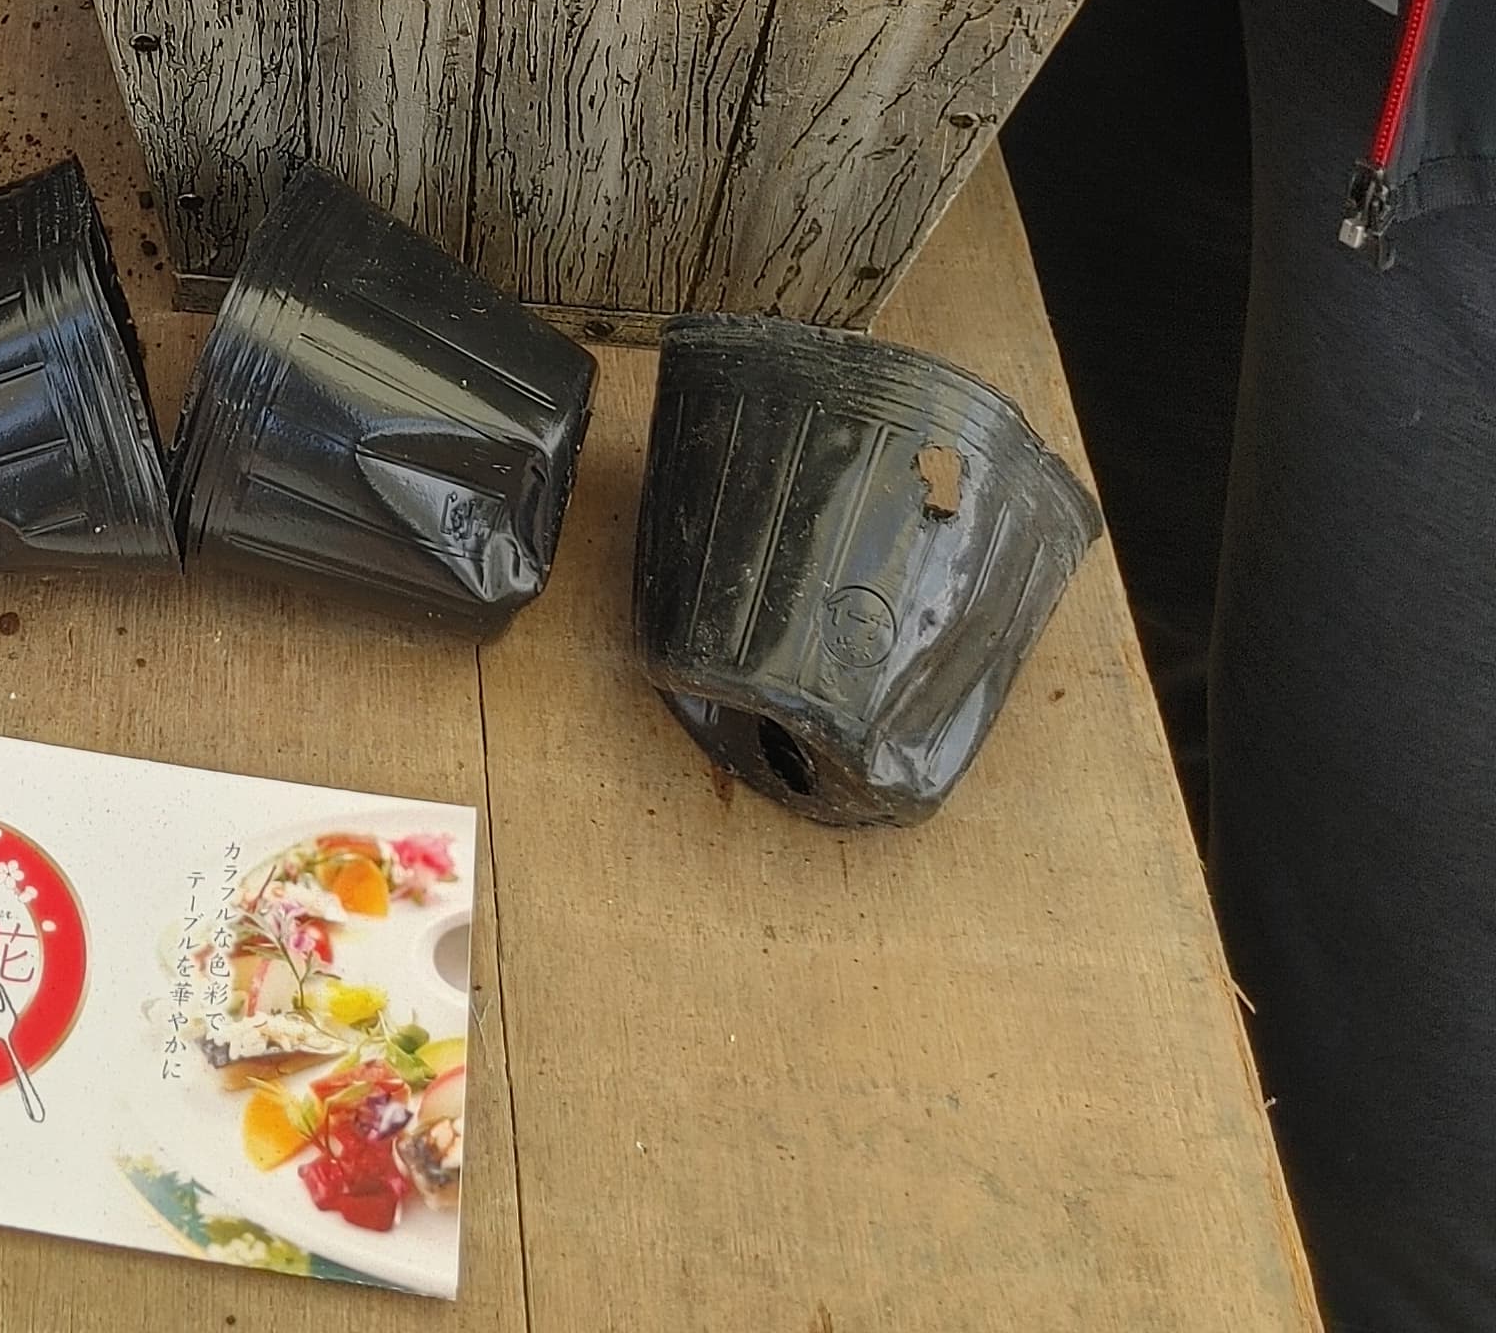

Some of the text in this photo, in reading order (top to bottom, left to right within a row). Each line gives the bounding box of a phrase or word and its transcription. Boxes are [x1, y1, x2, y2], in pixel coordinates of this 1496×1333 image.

[161, 871, 206, 1080] テーブルを華やかに
[204, 841, 241, 1032] カラフルな色彩で
